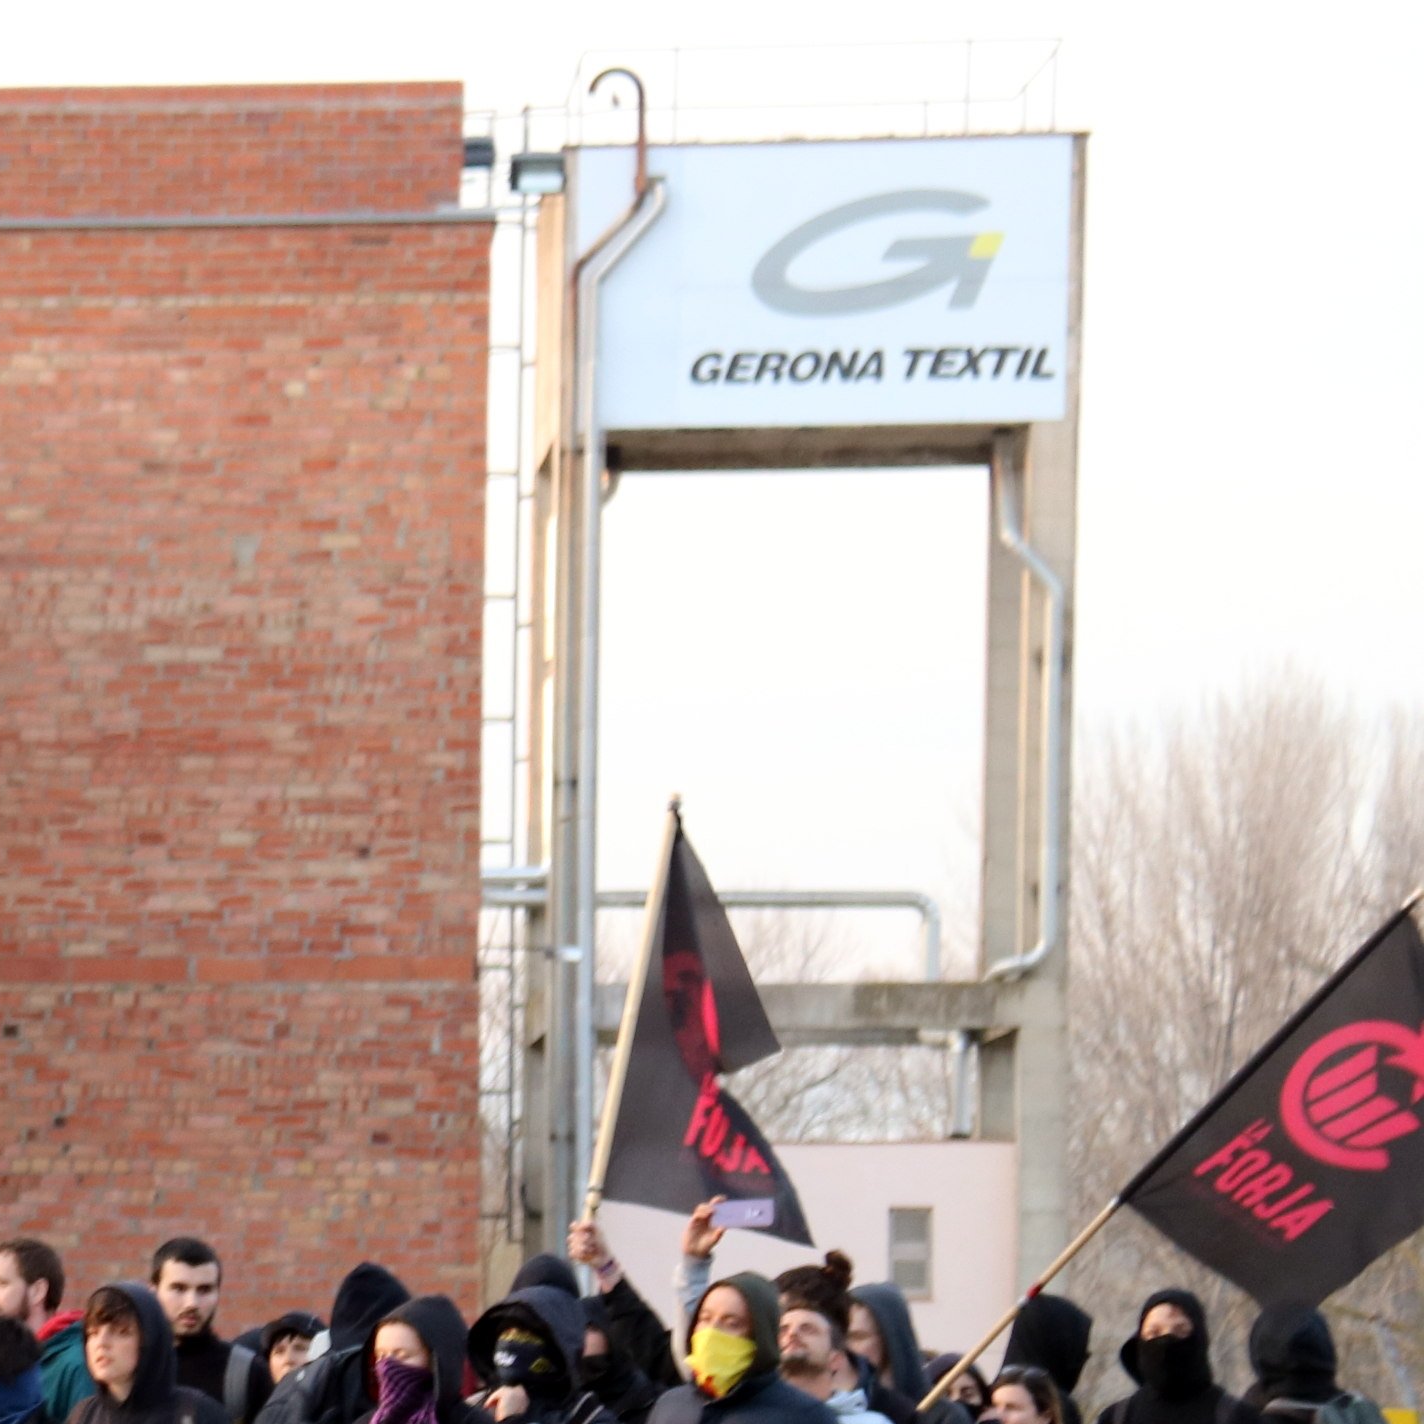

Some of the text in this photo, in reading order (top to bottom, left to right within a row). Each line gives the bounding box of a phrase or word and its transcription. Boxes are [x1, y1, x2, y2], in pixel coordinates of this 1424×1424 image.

[689, 345, 1056, 386] GERONA TEXTIL
[1192, 1130, 1336, 1243] FORJA
